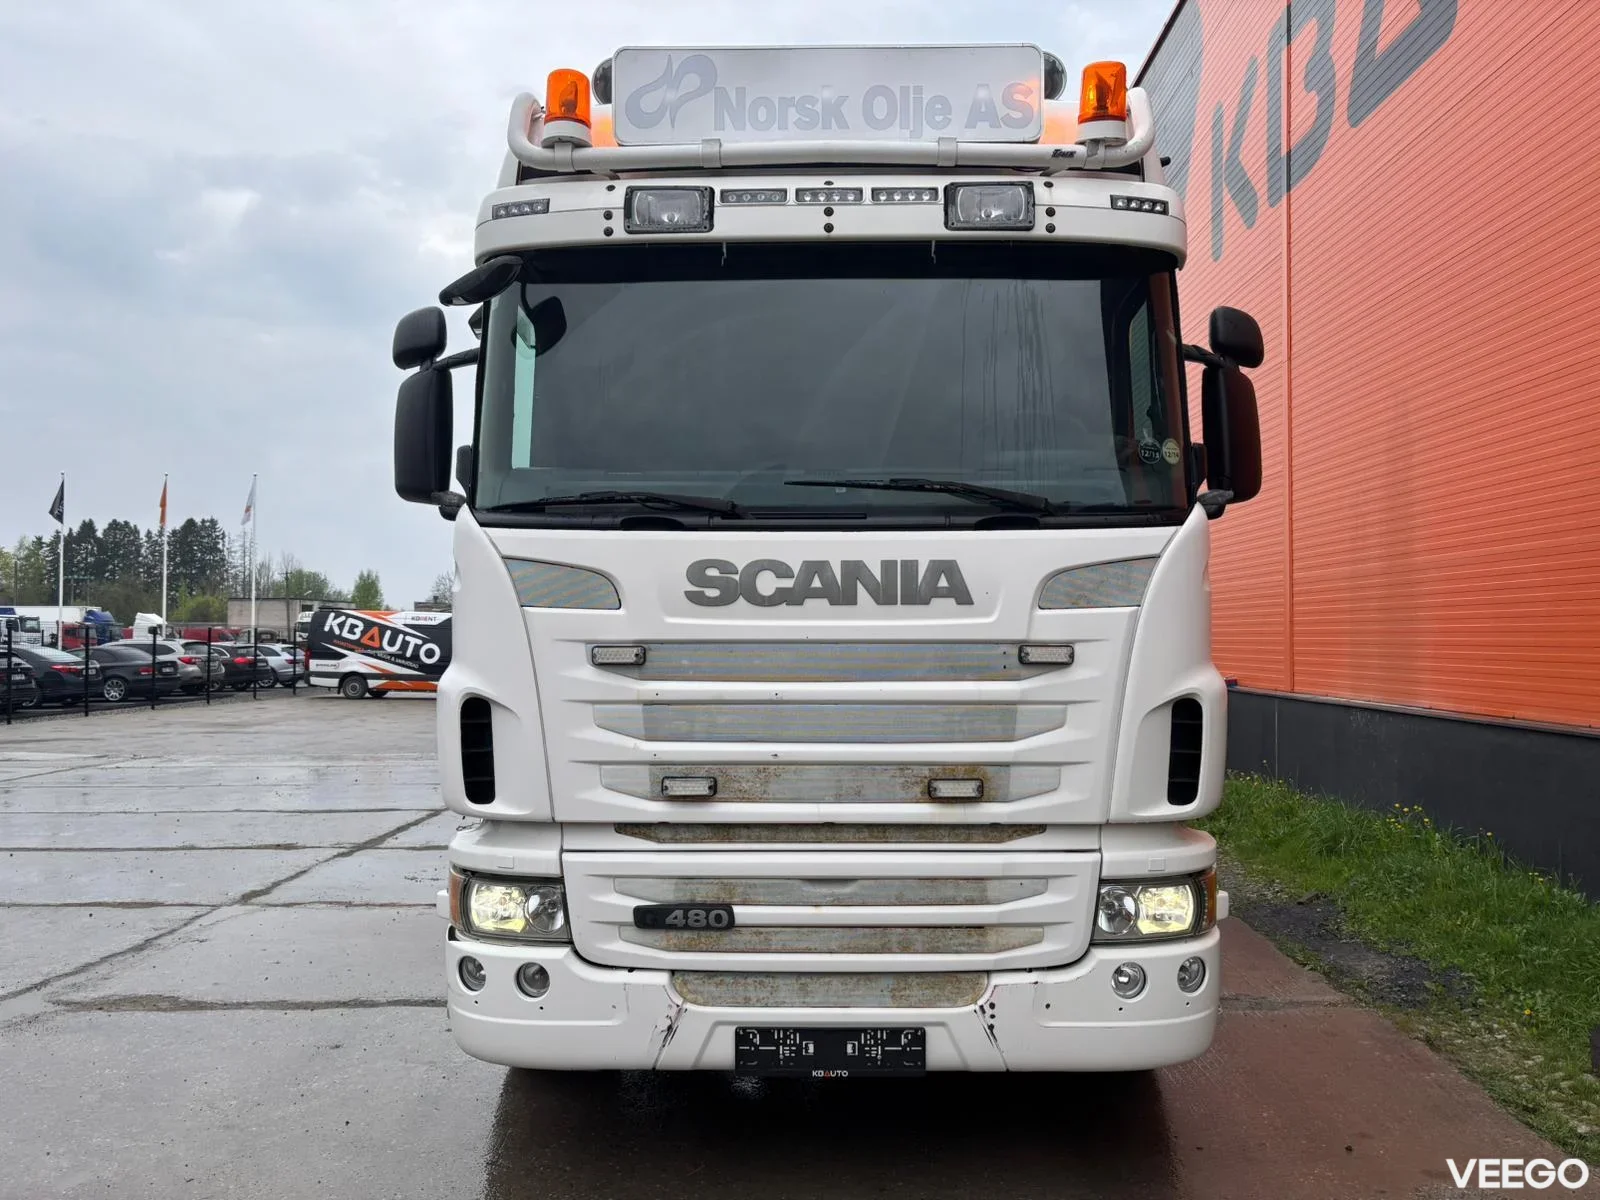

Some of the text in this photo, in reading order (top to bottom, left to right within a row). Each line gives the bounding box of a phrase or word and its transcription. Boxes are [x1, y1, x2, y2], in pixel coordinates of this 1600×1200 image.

[713, 82, 1034, 139] Norsk Olje AS
[684, 558, 975, 607] SCANIA
[323, 611, 441, 665] KBAUTO
[665, 909, 729, 928] 480
[812, 1069, 849, 1078] KBAUTO
